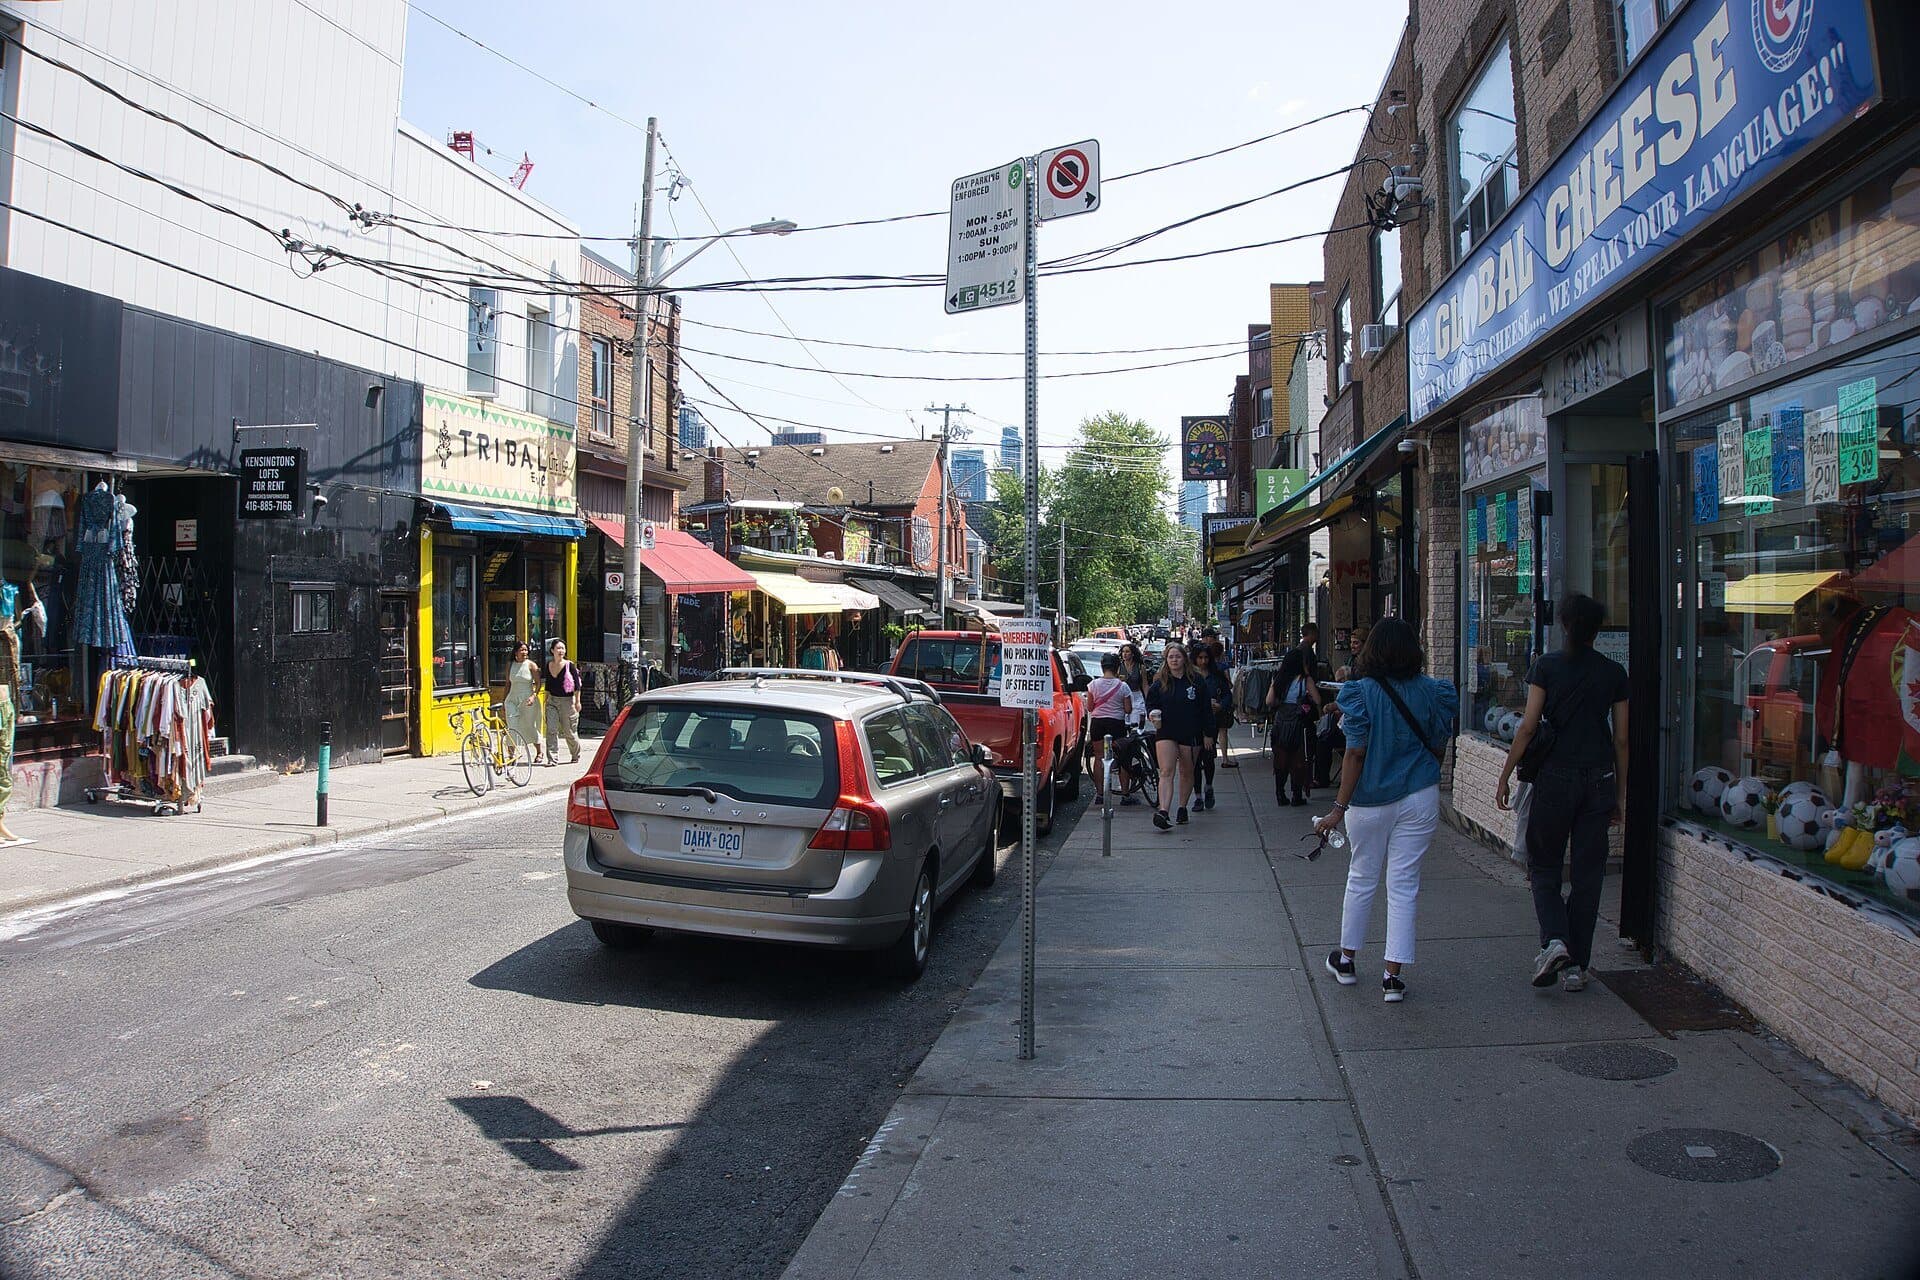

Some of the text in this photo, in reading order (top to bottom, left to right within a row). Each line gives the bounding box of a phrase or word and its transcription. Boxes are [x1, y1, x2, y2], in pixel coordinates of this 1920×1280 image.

[955, 172, 1000, 191] PAY PARKING
[1435, 222, 1534, 361] GLOBAL
[1545, 1, 1737, 267] CHEESE
[955, 186, 989, 201] ENFORCED
[966, 215, 988, 228] MON
[996, 208, 1013, 220] SAT
[958, 227, 987, 240] 7:00AM
[993, 217, 1018, 232] 9:00PM
[979, 235, 999, 247] SUN
[957, 250, 986, 263] 1:00PM
[992, 242, 1018, 256] 9:00PM
[980, 280, 1016, 297] 4512
[1475, 342, 1488, 370] TO
[1547, 277, 1570, 316] WE
[1574, 233, 1623, 301] SPEAK
[1622, 190, 1679, 259] YOUR
[1189, 422, 1226, 441] WELCOME
[458, 430, 547, 472] TRIBAL
[245, 456, 295, 467] KENSINGTONS
[259, 468, 279, 479] LOFTS
[252, 481, 285, 491] FOR RENT
[245, 500, 292, 511] 416-885-7166
[1002, 632, 1049, 645] EMERGENCY
[1004, 648, 1049, 660] NO PARKING
[1004, 664, 1050, 676] ON THIS SIDE
[1005, 679, 1046, 691] OF STREET
[655, 802, 767, 819] VOLVO
[683, 829, 740, 850] DAHX 020
